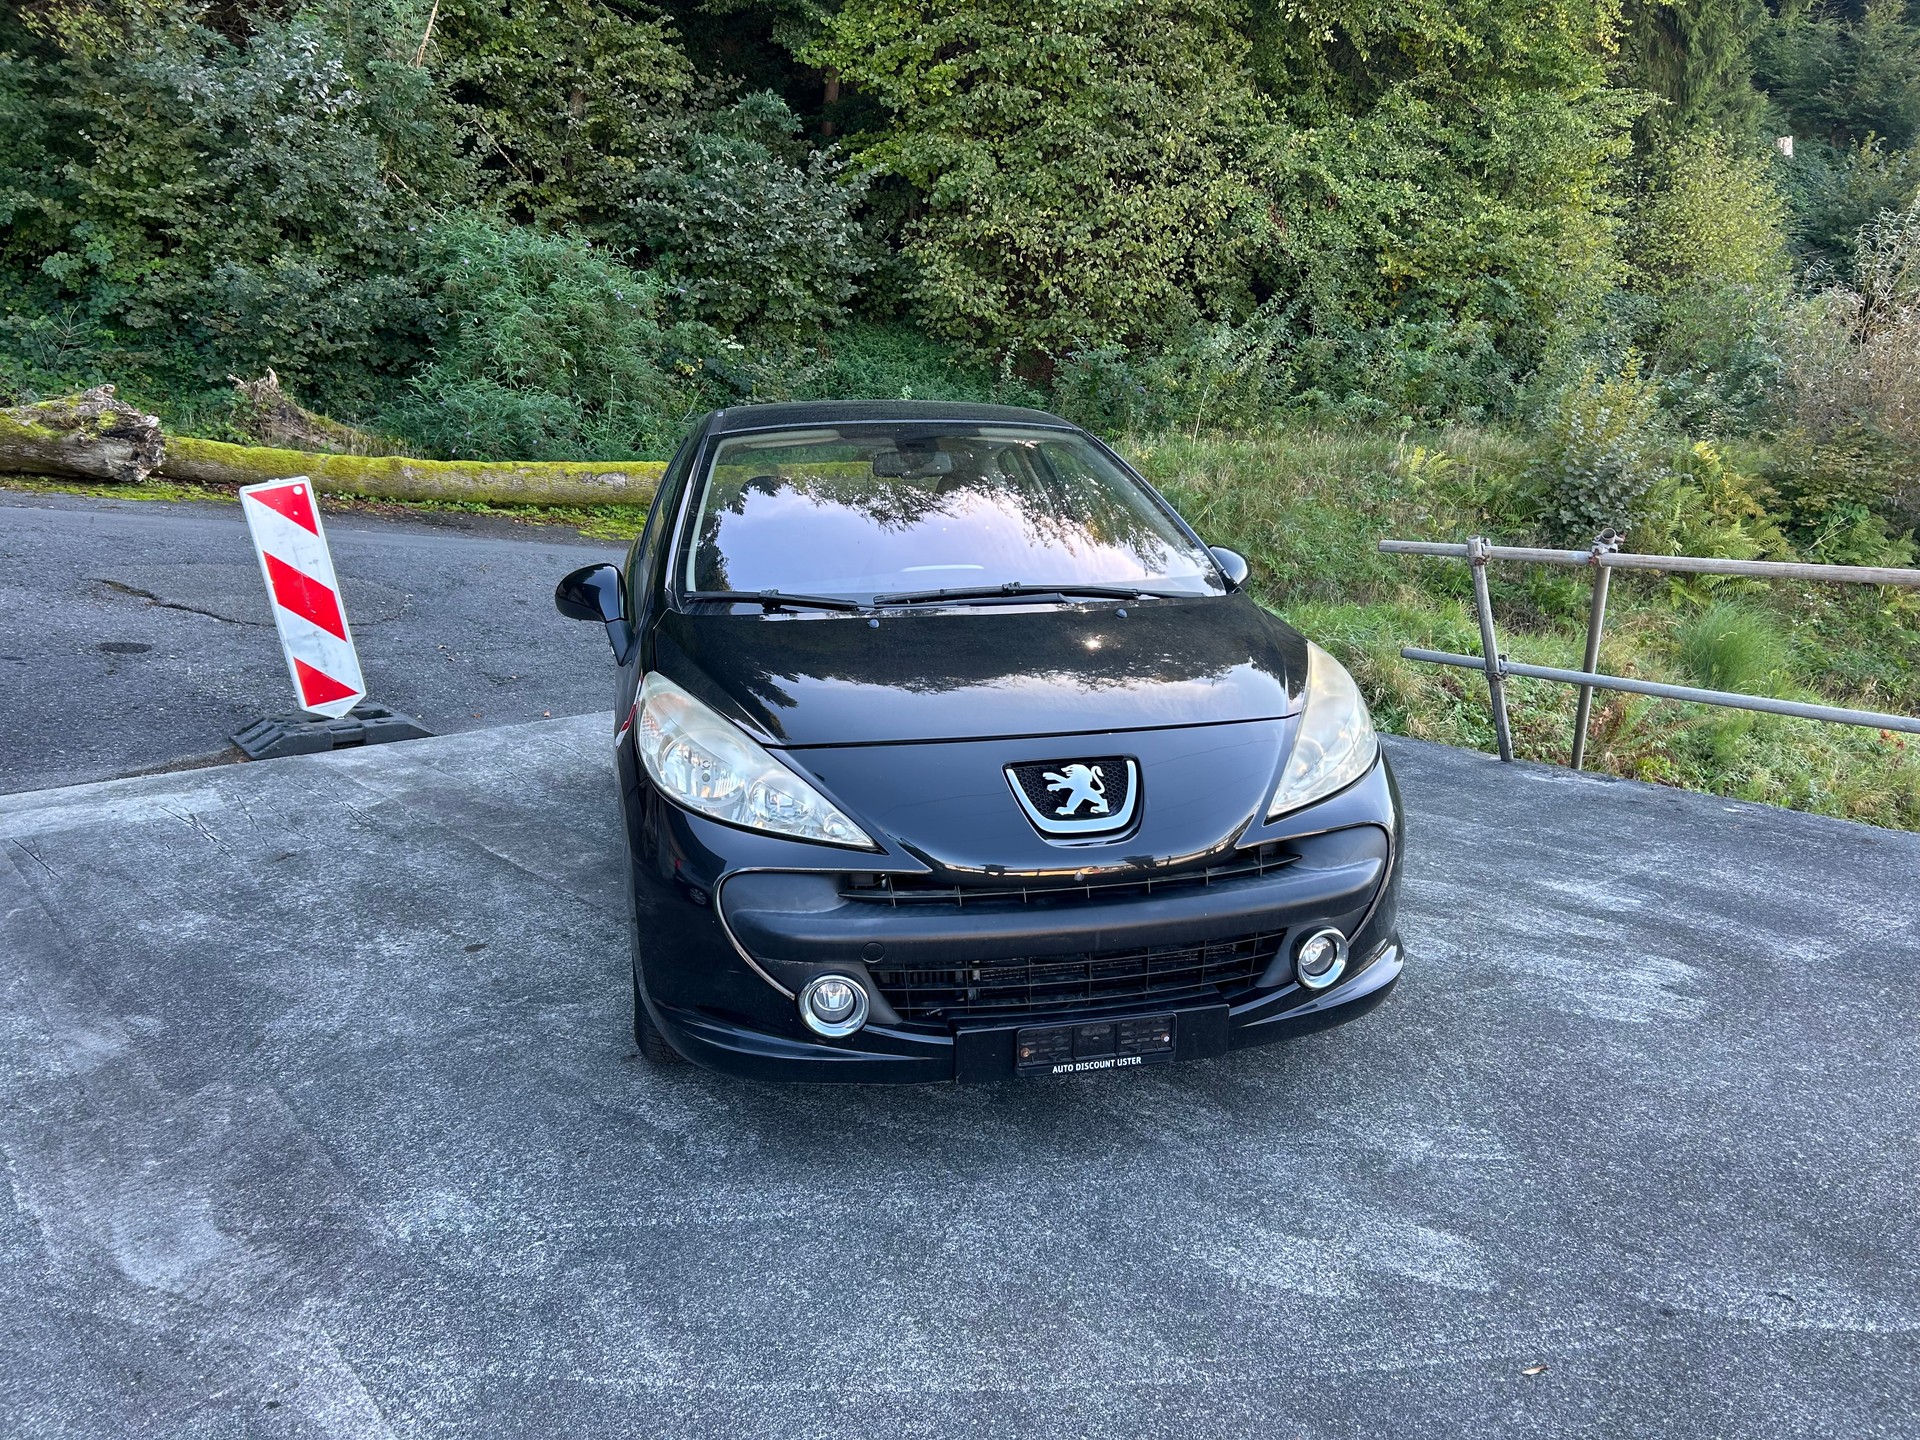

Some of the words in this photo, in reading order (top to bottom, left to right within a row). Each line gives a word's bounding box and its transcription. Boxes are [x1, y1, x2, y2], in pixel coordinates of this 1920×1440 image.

[1052, 1064, 1074, 1074] AUTO
[1075, 1059, 1115, 1072] DISCOUNT
[1116, 1056, 1142, 1067] USTER
